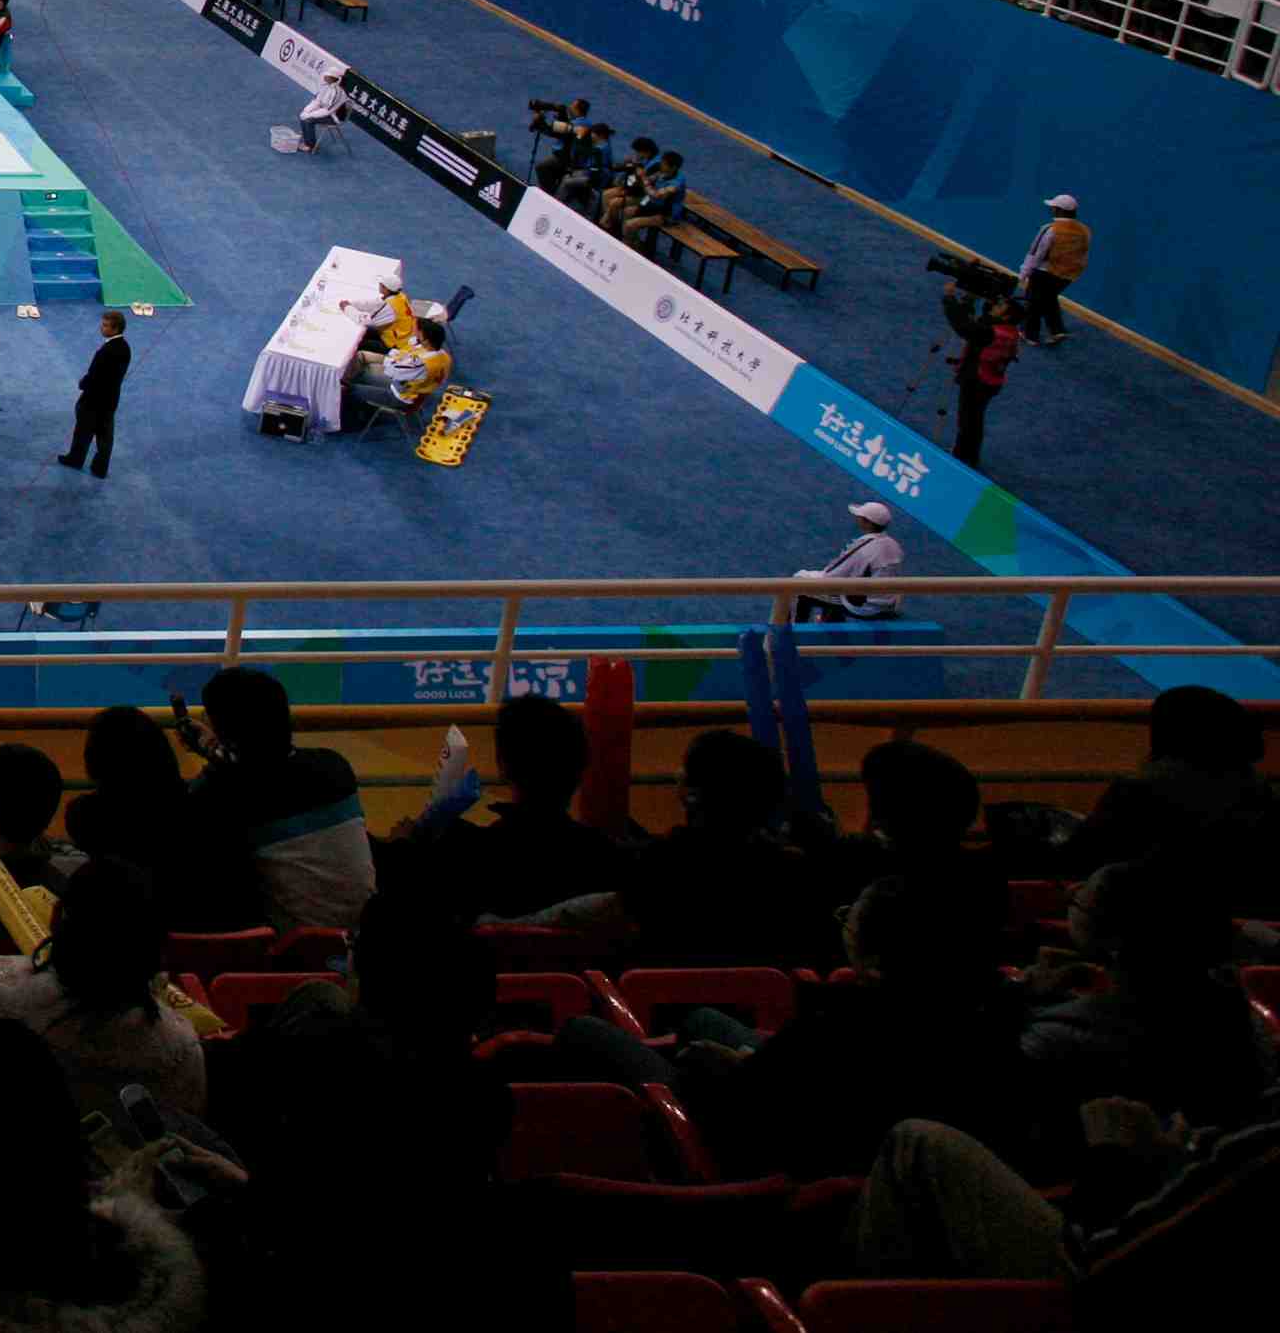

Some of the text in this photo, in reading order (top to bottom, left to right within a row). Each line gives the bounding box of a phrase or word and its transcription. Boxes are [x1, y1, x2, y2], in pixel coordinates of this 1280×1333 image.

[348, 85, 408, 131] 上海大众汽车
[818, 403, 931, 498] 好运北京
[414, 690, 477, 699] GOOD LUCK
